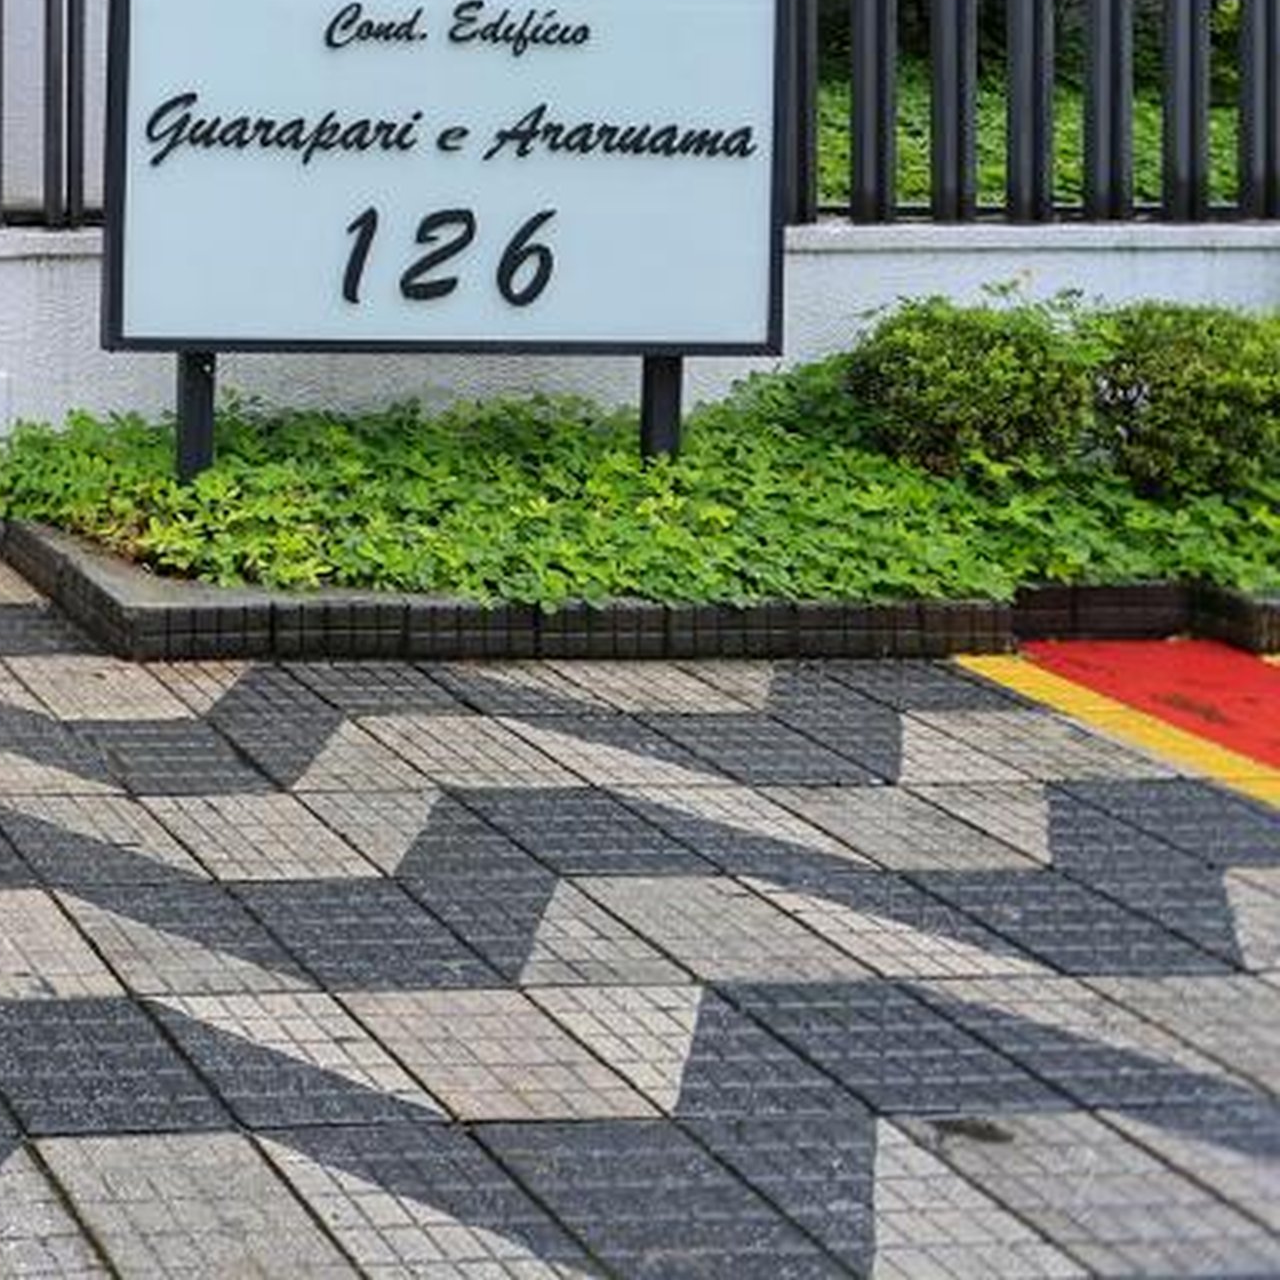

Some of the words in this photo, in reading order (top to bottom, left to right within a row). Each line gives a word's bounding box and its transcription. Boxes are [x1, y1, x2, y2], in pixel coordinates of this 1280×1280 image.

[324, 2, 427, 50] Cond.
[448, 0, 591, 58] Edifício
[145, 92, 423, 167] Guarapari
[436, 126, 470, 152] e
[482, 103, 757, 161] Araruama
[341, 207, 556, 308] 126
